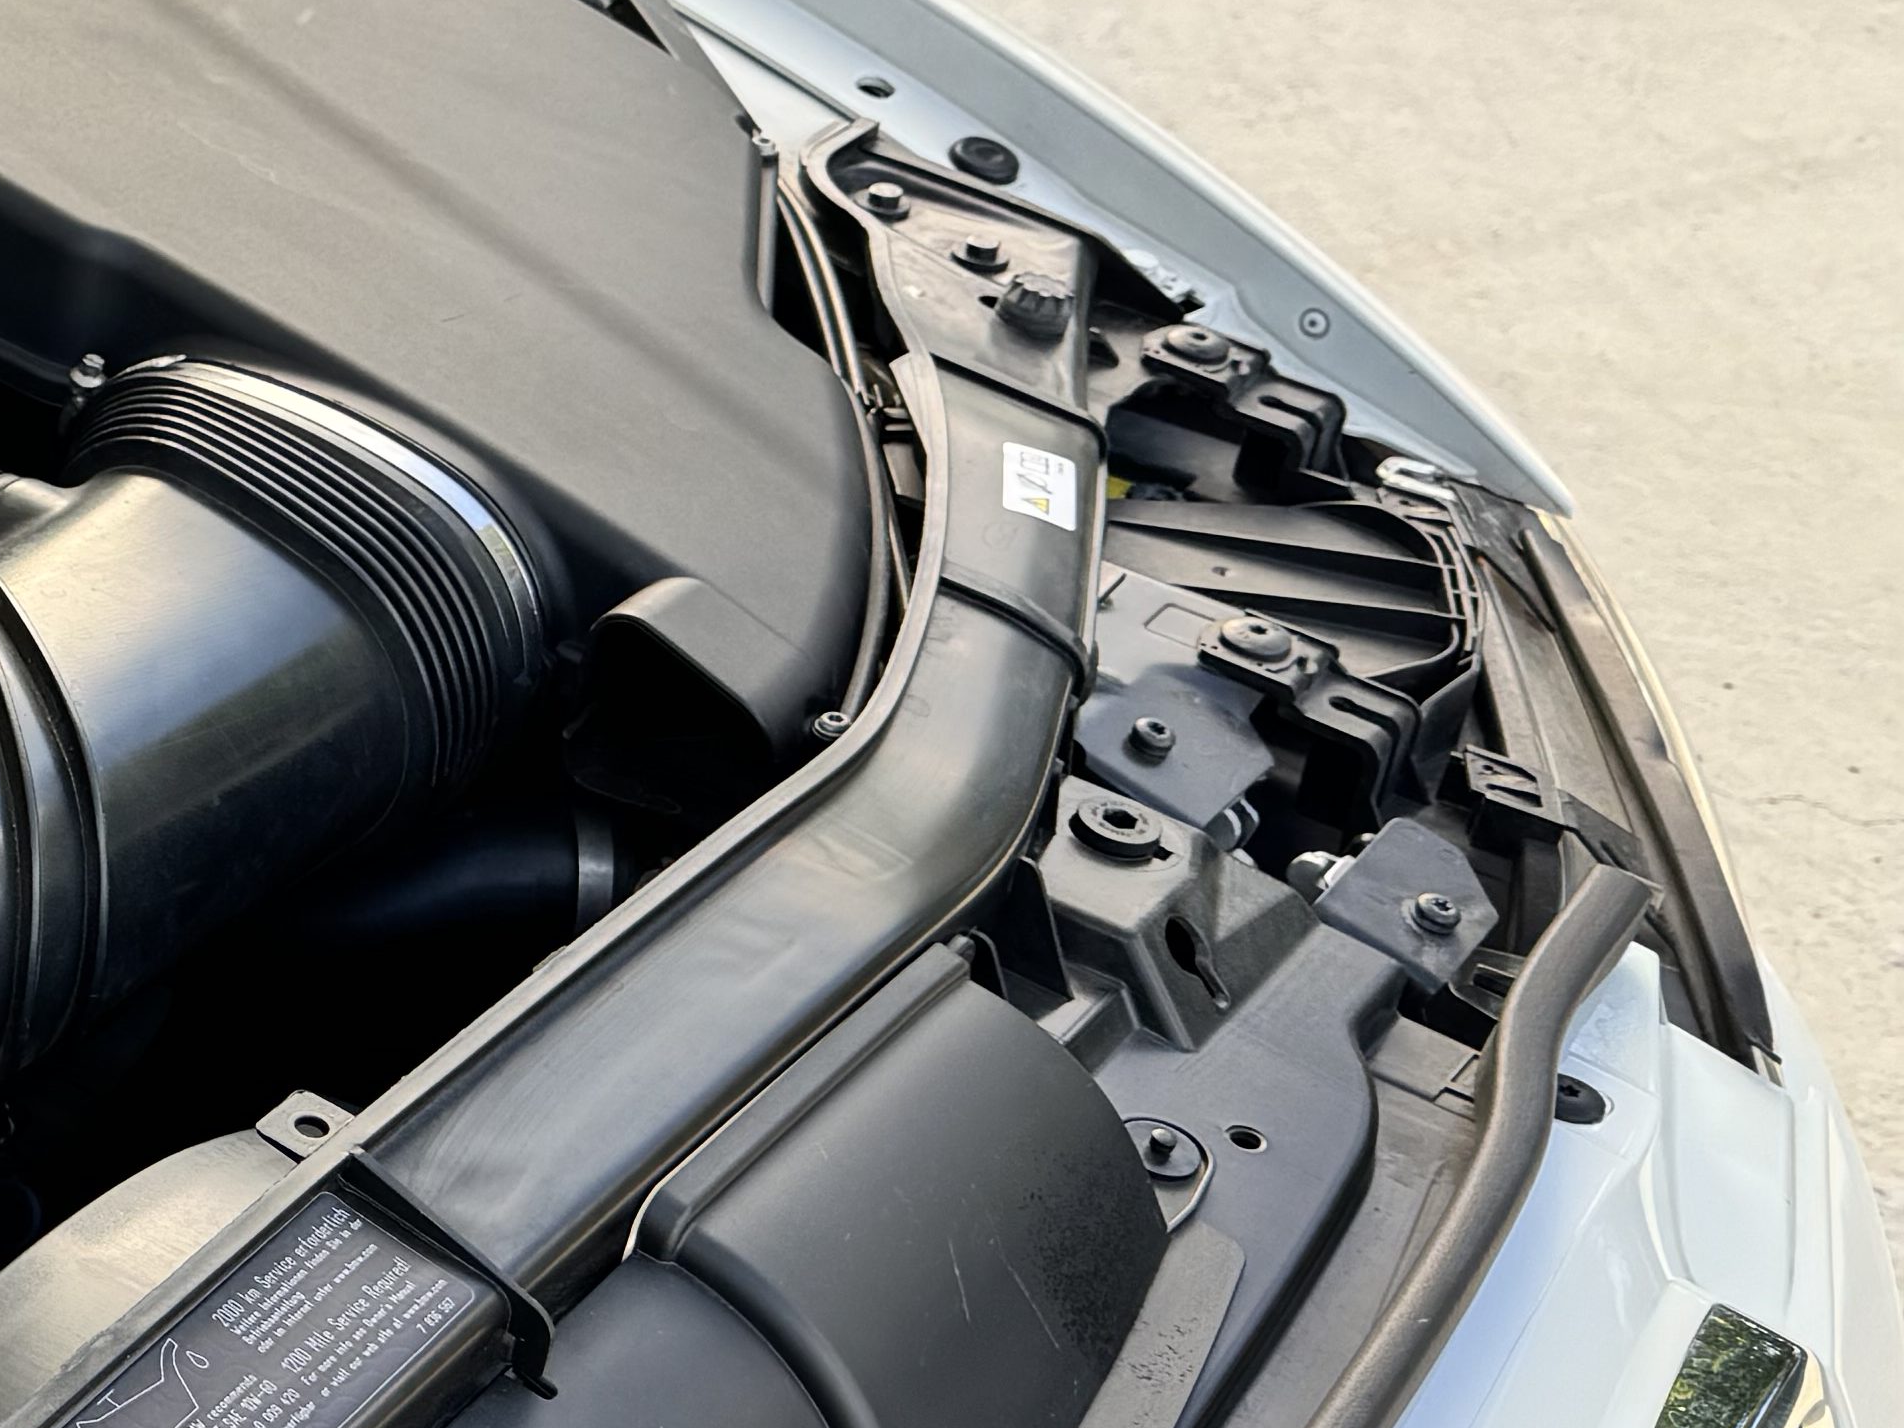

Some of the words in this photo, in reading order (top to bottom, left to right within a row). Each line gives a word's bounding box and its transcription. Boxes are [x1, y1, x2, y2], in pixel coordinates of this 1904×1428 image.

[211, 1299, 244, 1327] 2000
[236, 1288, 261, 1304] km
[253, 1256, 296, 1288] Service
[294, 1206, 350, 1256] erforderlich
[280, 1347, 312, 1373] 1200
[304, 1330, 334, 1351] Mile
[326, 1298, 369, 1330] Service
[361, 1255, 410, 1299] Required!
[416, 1323, 426, 1333] 7
[206, 1374, 257, 1420] recommends
[222, 1408, 247, 1428] SAE
[240, 1379, 277, 1411] 10W-60
